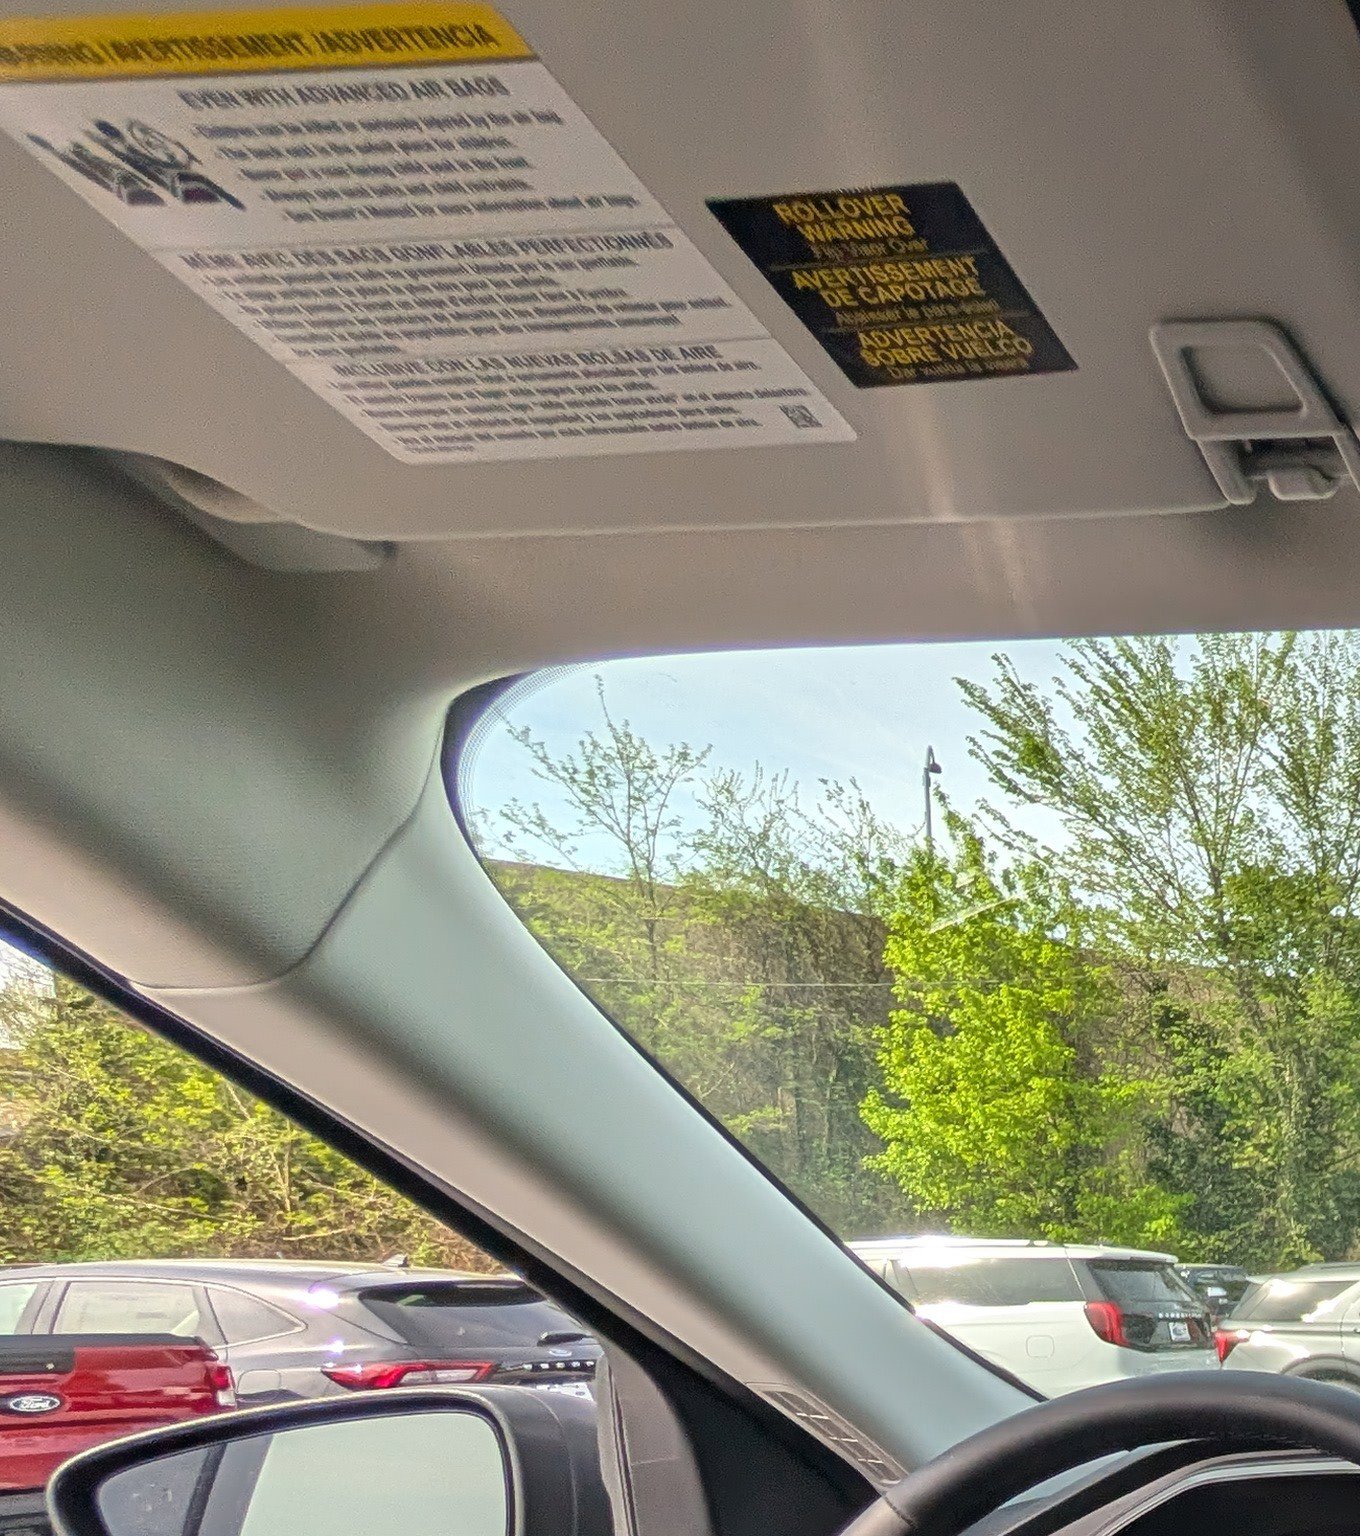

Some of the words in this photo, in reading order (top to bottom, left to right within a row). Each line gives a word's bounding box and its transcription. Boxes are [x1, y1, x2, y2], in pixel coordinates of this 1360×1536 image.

[294, 81, 411, 104] ADVANCED
[408, 79, 449, 99] AIR
[772, 193, 911, 226] ROLLOVER
[796, 215, 915, 242] WARNING
[791, 256, 981, 290] AVERTISSEMENT
[820, 289, 859, 308] DE
[860, 277, 987, 305] CAPOTAGE
[858, 320, 1016, 350] ADVERTENCIA
[860, 345, 942, 368] SOBRE
[941, 338, 1033, 363] VUELCO
